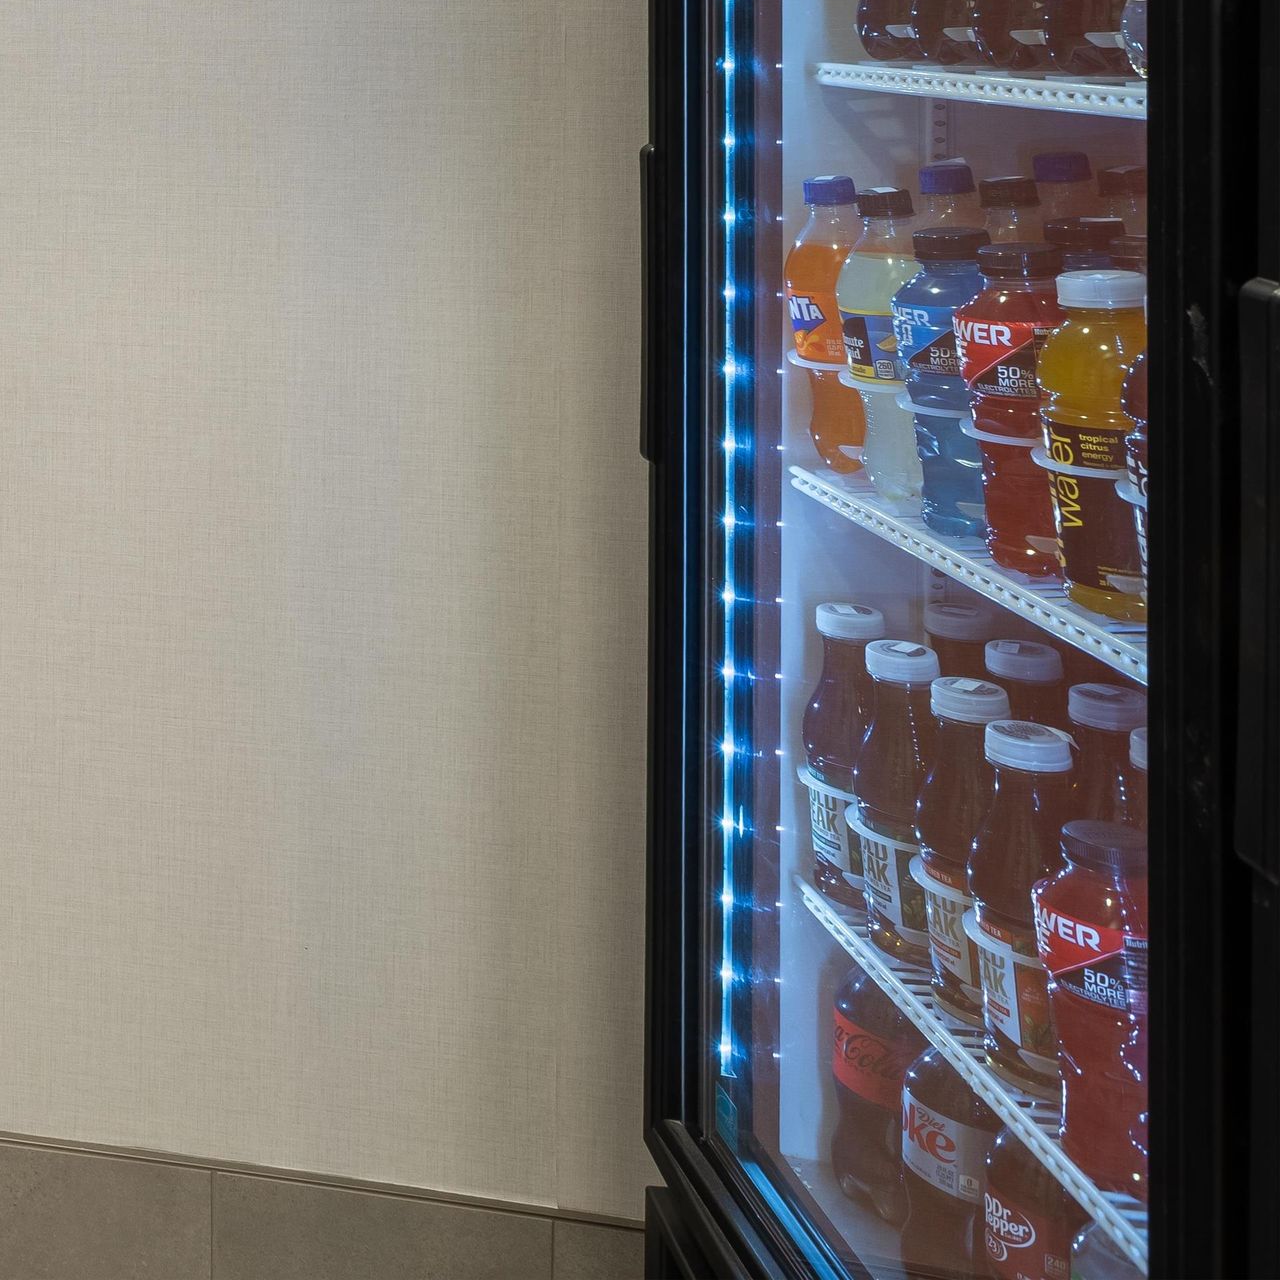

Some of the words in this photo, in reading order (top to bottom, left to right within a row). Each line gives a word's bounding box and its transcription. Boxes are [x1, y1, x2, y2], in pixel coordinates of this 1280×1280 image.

[997, 366, 1034, 379] 50%
[978, 383, 1037, 395] ELECTROLYTES
[999, 378, 1035, 388] MORE
[1079, 433, 1118, 444] tropical
[1080, 443, 1109, 451] citrus
[1081, 451, 1114, 462] energy
[1084, 968, 1123, 991] 50%
[1085, 982, 1126, 999] MORE
[917, 1107, 946, 1131] Diet
[992, 1198, 1012, 1220] Dr
